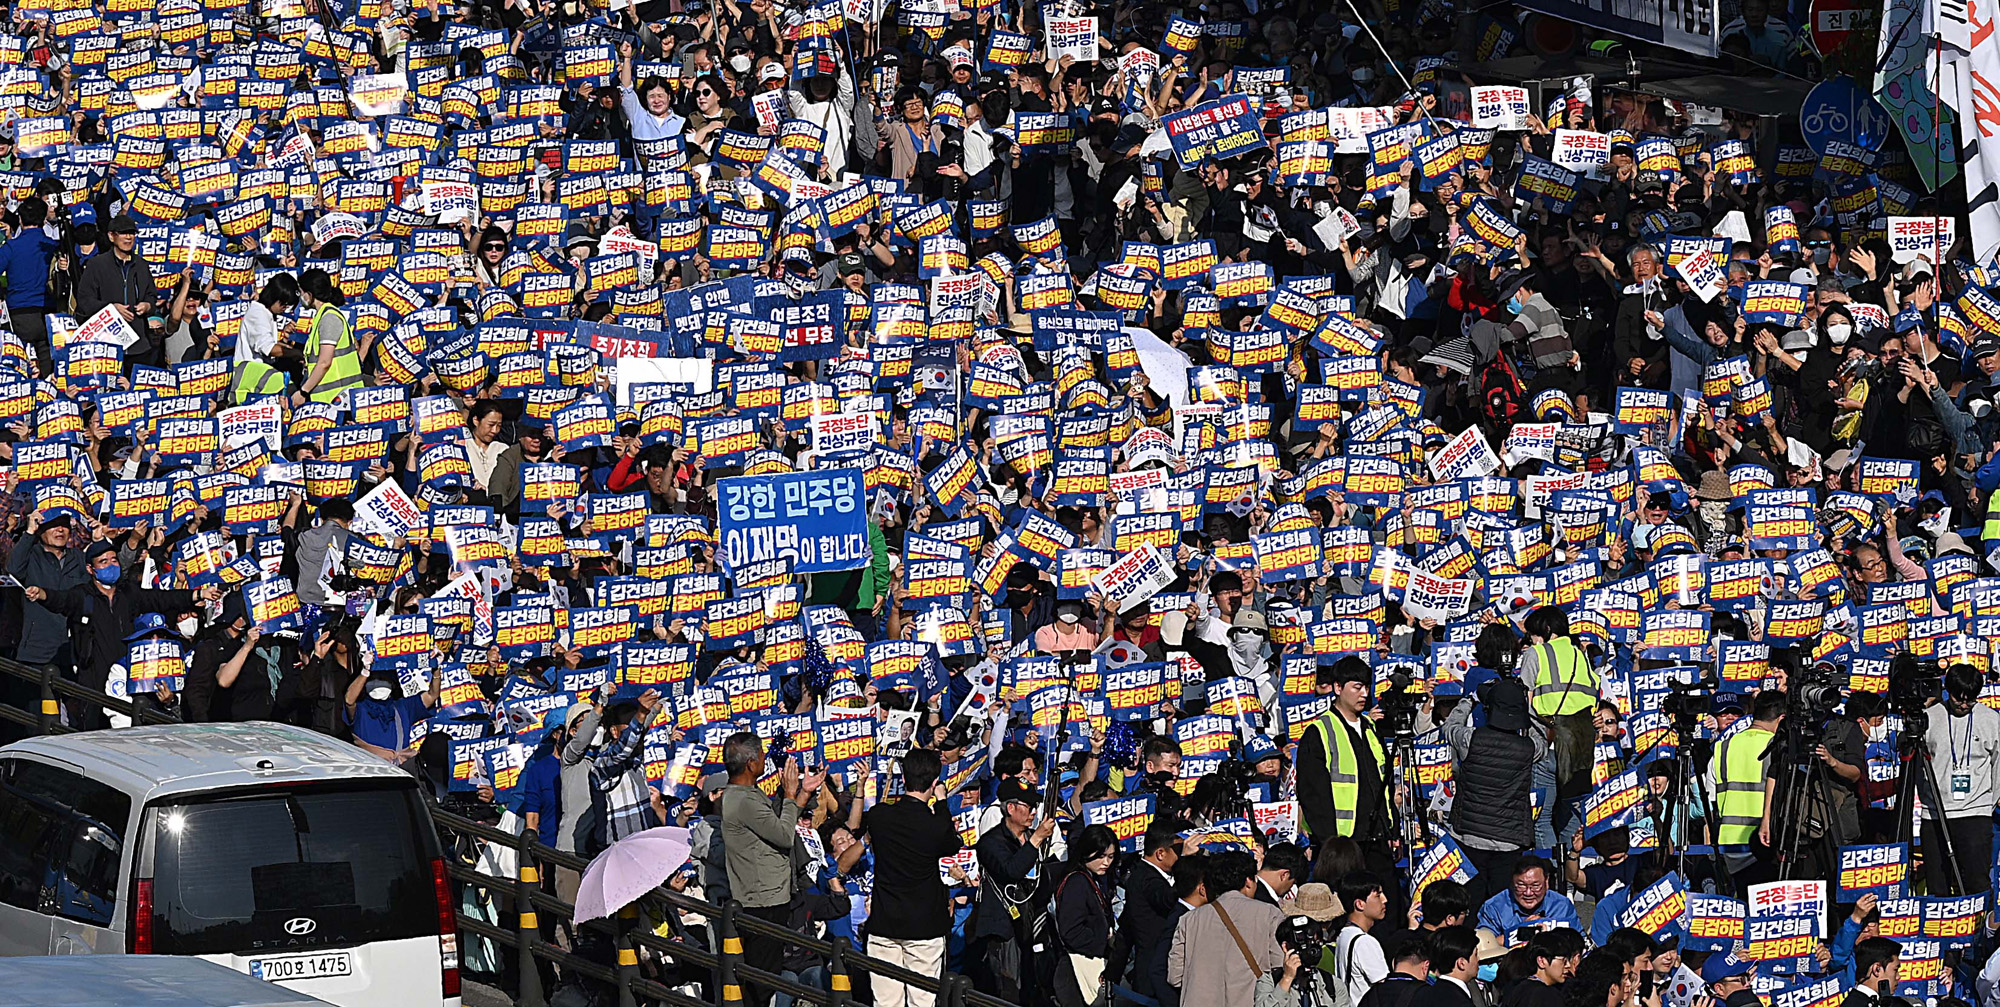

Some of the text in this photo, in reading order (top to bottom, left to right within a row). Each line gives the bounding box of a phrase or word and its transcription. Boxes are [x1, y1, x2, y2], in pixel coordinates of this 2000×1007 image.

[1050, 19, 1092, 34] 국정농단
[239, 80, 285, 95] 김건희를
[1478, 89, 1524, 103] 국정농단
[239, 95, 288, 110] 특검하라!
[1477, 102, 1529, 119] 진상명!
[389, 118, 437, 135] 김건희를
[1019, 114, 1069, 128] 김건희를
[119, 139, 164, 155] 김건희를
[385, 132, 440, 151] 특검하라!
[1018, 129, 1074, 146] 특검하라!
[1561, 135, 1608, 150] 국정농단
[569, 142, 616, 156] 김건희를
[1825, 141, 1875, 165] 김건희를
[116, 152, 165, 168] 특검하라!
[568, 154, 619, 172] 특검하라!
[1637, 156, 1682, 174] 특검하라!
[1526, 160, 1577, 186] 김건희를
[139, 184, 185, 207] 김건희를
[429, 186, 474, 199] 국정농단
[1519, 172, 1577, 203] 특검하라!
[216, 197, 265, 220] 김건희를
[339, 196, 391, 211] 특검하라!
[430, 199, 478, 213] 진상규명!
[824, 185, 870, 212] 김건희를
[133, 197, 184, 221] 특검하라!
[827, 194, 878, 228] 특검하라!
[1474, 201, 1519, 237] 김건희를
[220, 209, 271, 236] 특검하라!
[1466, 213, 1516, 250] 특검하라!
[1895, 219, 1948, 235] 국정농단
[1163, 241, 1211, 263] 김건희를
[1164, 256, 1218, 280] 특검하라!
[1215, 266, 1266, 283] 김건희를
[1215, 279, 1272, 298] 특검하라!
[1747, 283, 1803, 298] 김건희를
[770, 303, 830, 325] 여론조작
[1744, 298, 1805, 314] 특검하라!
[479, 326, 528, 342] 김건희를
[805, 325, 834, 345] 무효
[477, 340, 530, 357] 특검하라!
[1325, 358, 1376, 375] 김건희를
[1324, 372, 1382, 388] 특검하라!
[355, 387, 405, 405] 김건희를
[1620, 391, 1668, 407] 김건희를
[222, 407, 275, 424] 국정농단
[354, 403, 409, 423] 특검하라!
[160, 419, 213, 437] 김건희를
[222, 421, 278, 437] 진상규명!
[701, 420, 753, 441] 김건희를
[818, 414, 869, 434] 국정농단
[994, 418, 1045, 436] 김건희를
[160, 436, 218, 455] 특검하라!
[329, 428, 383, 447] 김건희를
[701, 435, 760, 457] 특검하라!
[819, 430, 873, 451] 진상규명!
[327, 440, 387, 461] 특검하라!
[1435, 430, 1475, 473] 국정농단
[1349, 458, 1398, 475] 김건희를
[114, 481, 166, 499] 김건희를
[936, 456, 987, 506] 특검하라!
[1109, 473, 1161, 490] 국정농단
[1346, 474, 1404, 493] 특검하라!
[113, 497, 170, 517] 특검하라!
[593, 493, 646, 514] 김건희를
[726, 476, 856, 521] 강한 민주당
[1753, 489, 1808, 505] 김건희를
[434, 509, 486, 525] 김건희를
[592, 510, 652, 532] 특검하라!
[1752, 505, 1807, 522] 김건희를
[1116, 514, 1172, 534] 김건희를
[1752, 519, 1815, 539] 특검하라!
[819, 533, 865, 564] 합니다
[1115, 529, 1178, 553] 특검하라!
[1255, 534, 1311, 556] 김건희를
[1101, 546, 1150, 590] 국정농단
[1258, 545, 1319, 571] 특검하라!
[908, 561, 963, 581] 김건희를
[1109, 555, 1163, 602] 진상규명!
[908, 578, 971, 599] 특검하라!
[1413, 573, 1468, 595] 국정농단
[1410, 589, 1467, 610] 진상규명!
[573, 610, 630, 629] 김건희를
[1645, 612, 1703, 628] 김건희를
[1772, 602, 1822, 620] 김건희를
[573, 622, 636, 646] 특검하라!
[1311, 618, 1368, 636] 김건희를
[1767, 617, 1824, 639] 특검하라!
[1313, 633, 1377, 654] 특검하라!
[1644, 628, 1709, 647] 특검하라!
[130, 641, 180, 659] 김건희를
[627, 644, 688, 664] 김건희를
[129, 657, 186, 680] 특검하라!
[625, 661, 694, 684] 특검하라!
[1106, 667, 1160, 689] 김건희를
[1105, 684, 1165, 709] 특검하라!
[822, 721, 872, 740] 김건희를
[1584, 774, 1638, 812] 김건희를
[1090, 798, 1148, 825] 김건희를
[1585, 784, 1648, 828] 특검하라!
[1842, 847, 1901, 868] 김건희를
[1840, 864, 1906, 889] 특검하라!
[1756, 883, 1819, 906] 국정농단
[1688, 898, 1746, 918] 김건희를
[1749, 918, 1811, 940] 김건희를
[253, 936, 346, 948] STARIA
[1748, 935, 1819, 961] 특검하라!
[309, 957, 347, 974] 1475
